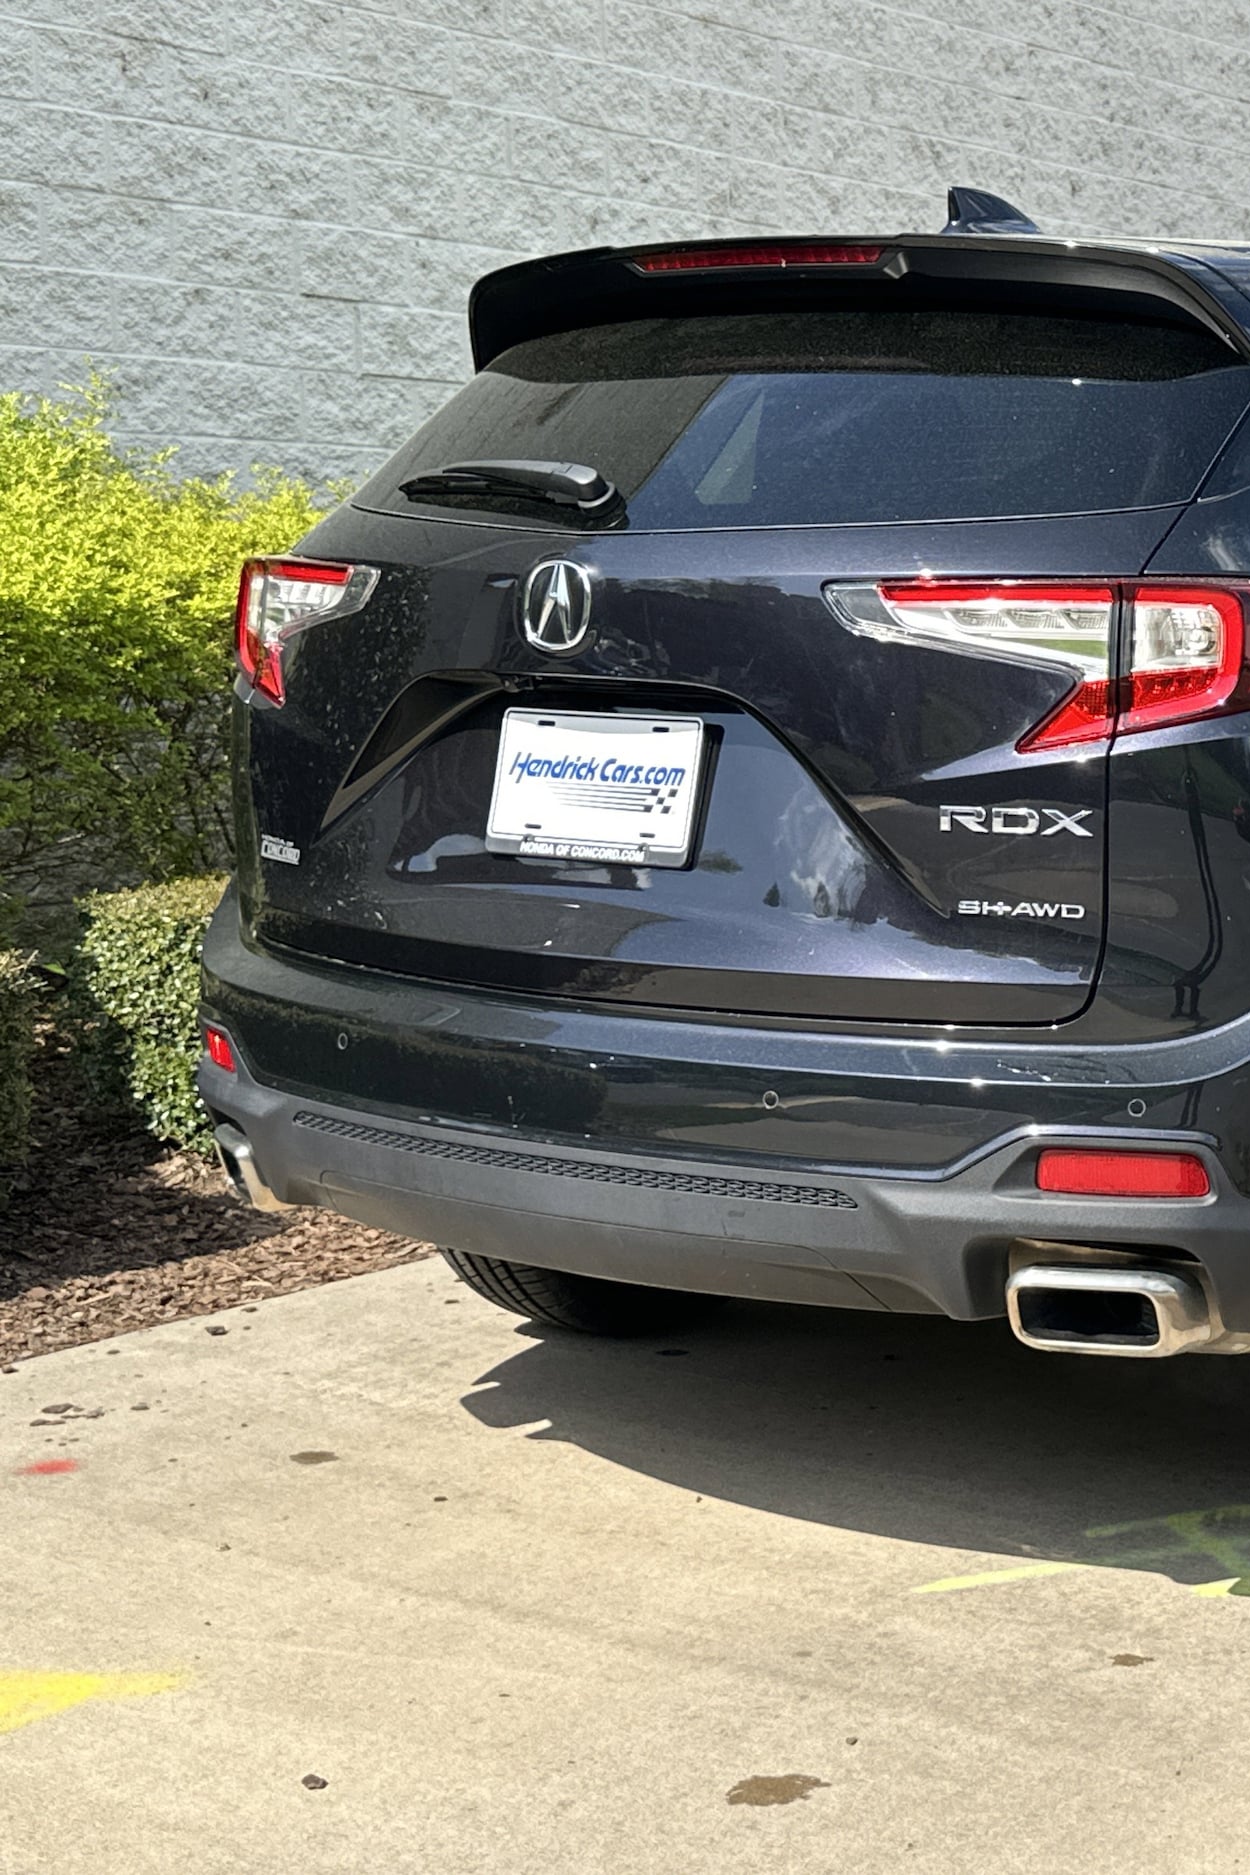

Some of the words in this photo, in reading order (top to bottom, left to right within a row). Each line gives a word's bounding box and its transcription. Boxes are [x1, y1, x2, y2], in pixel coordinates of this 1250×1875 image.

[940, 805, 1093, 837] RDX
[520, 841, 554, 855] HONDA
[556, 844, 571, 856] OF
[571, 845, 644, 862] CONCORD.COM
